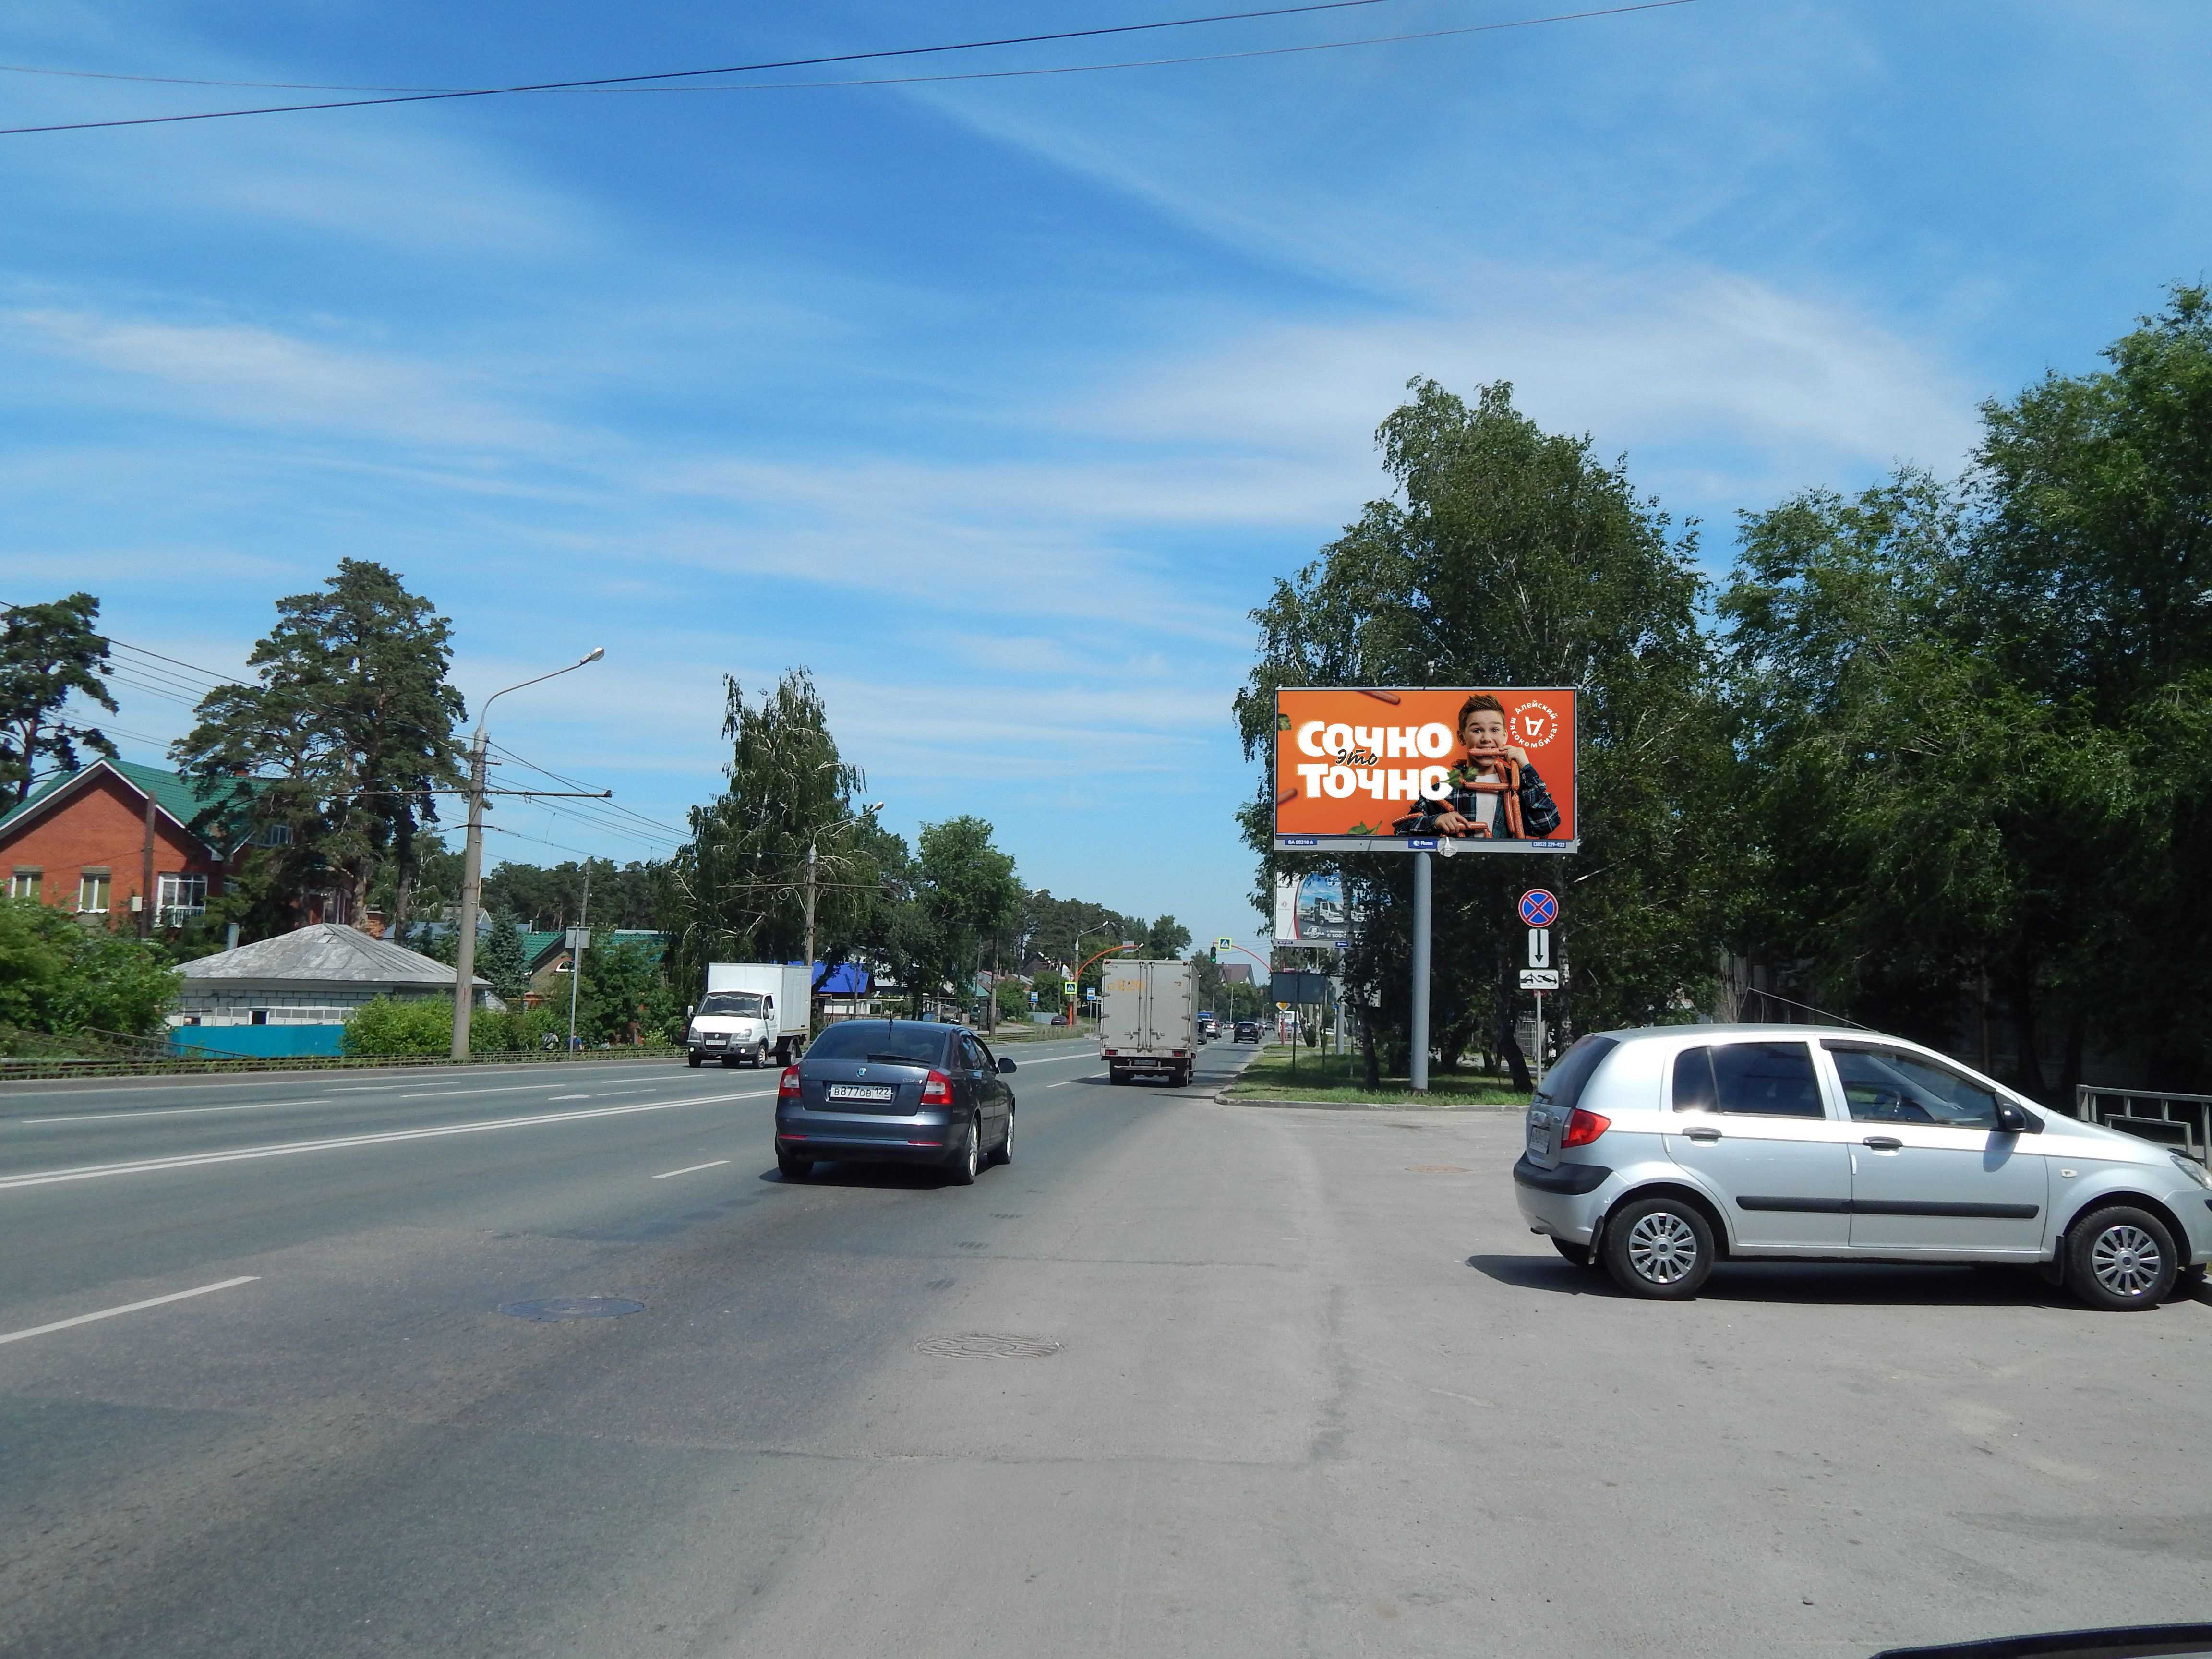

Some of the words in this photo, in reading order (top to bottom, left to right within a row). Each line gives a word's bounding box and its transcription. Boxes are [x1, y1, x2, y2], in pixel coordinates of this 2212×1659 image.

[1515, 700, 1558, 720] Алейский
[1298, 721, 1452, 757] СОЧНО
[1510, 717, 1558, 748] мясокомбинат
[1298, 763, 1453, 800] ТОЧНО
[874, 1087, 889, 1095] 122
